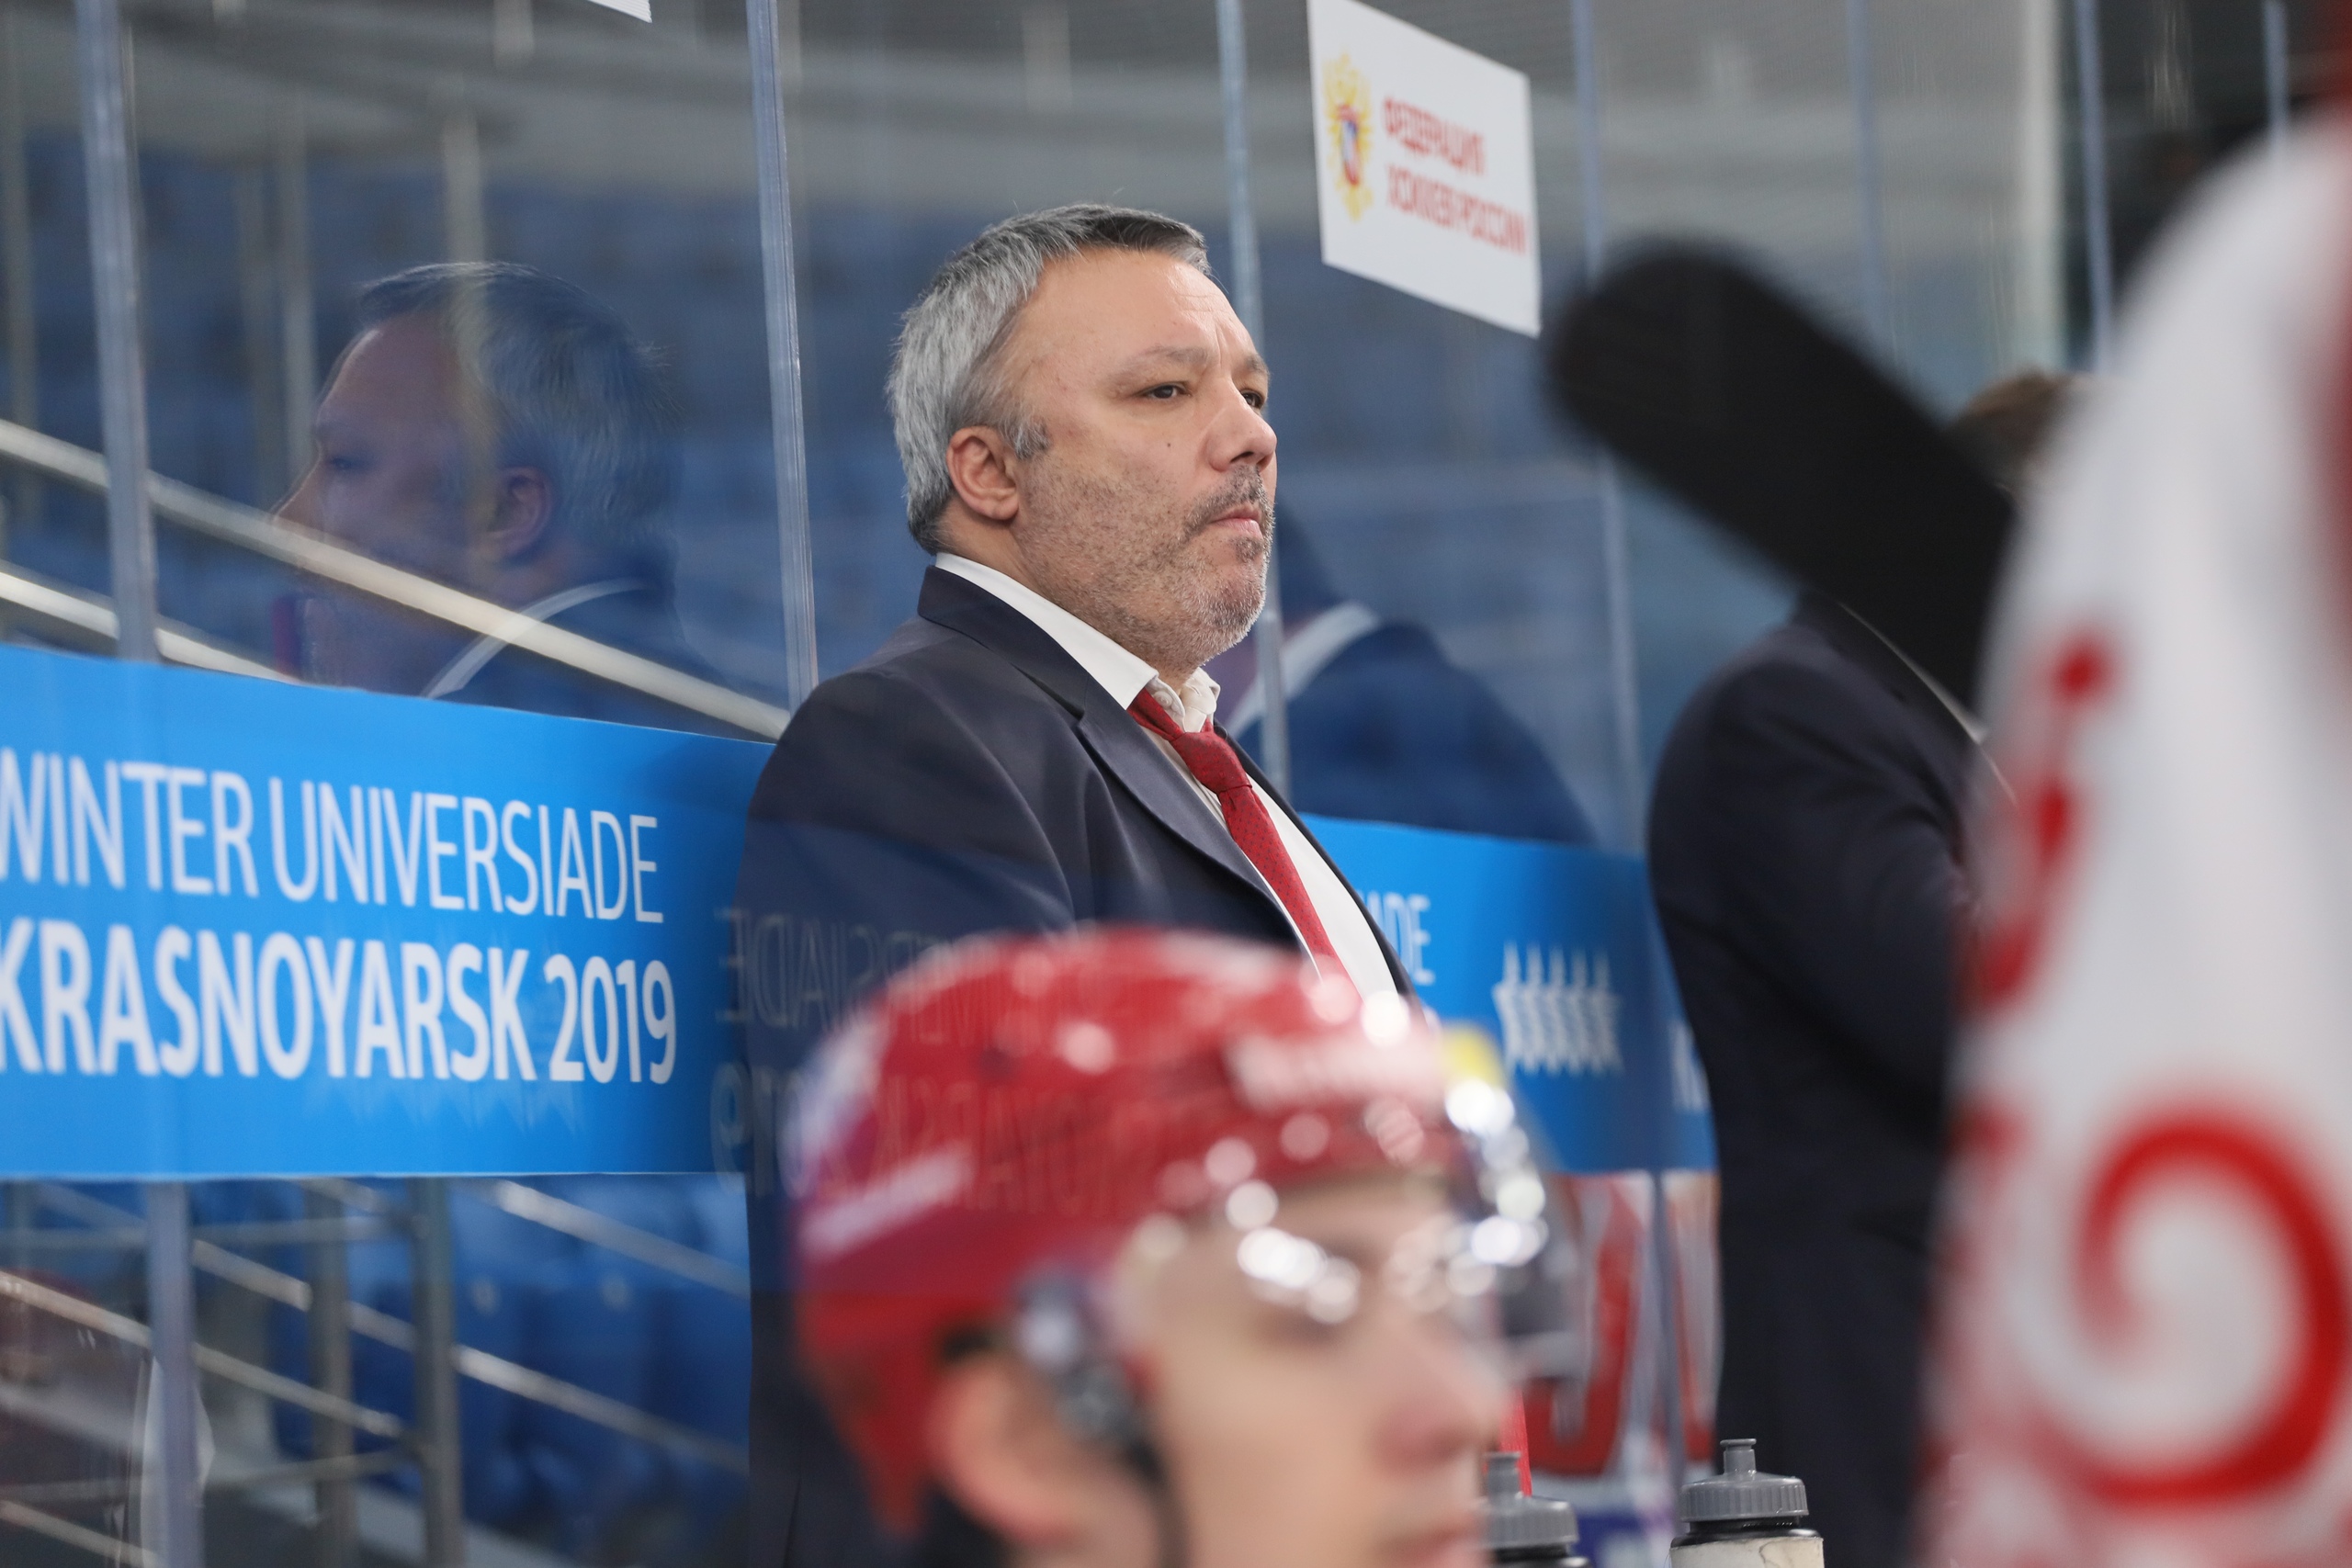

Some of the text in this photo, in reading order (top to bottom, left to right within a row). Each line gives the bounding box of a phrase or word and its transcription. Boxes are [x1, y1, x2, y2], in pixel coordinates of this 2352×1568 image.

[0, 747, 664, 924] WINTER UNIVERSIADE
[0, 916, 678, 1086] KRASNOYARSK 2019
